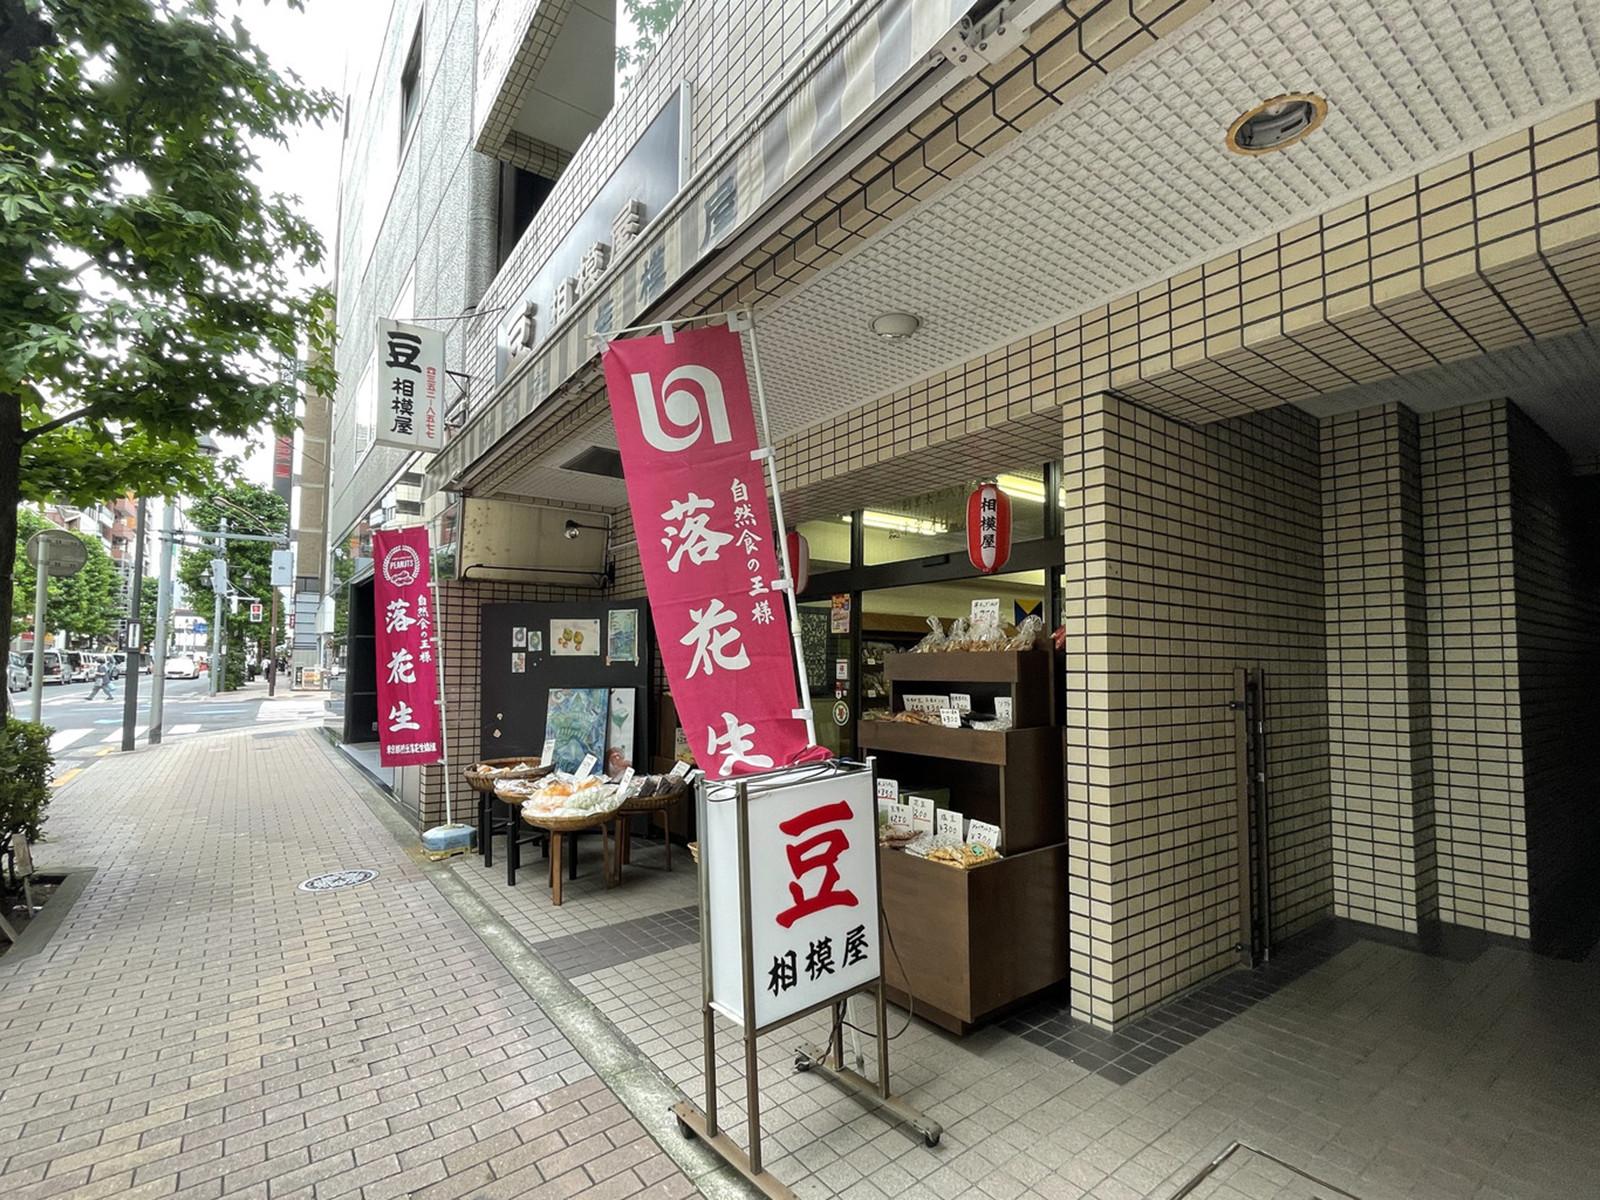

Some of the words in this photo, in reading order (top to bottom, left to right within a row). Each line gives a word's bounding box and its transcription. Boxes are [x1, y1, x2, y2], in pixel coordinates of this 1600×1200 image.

[385, 331, 422, 374] 豆
[390, 377, 415, 435] 相模屋
[729, 477, 776, 626] 自然食の王様
[980, 498, 997, 550] 相模屋
[390, 559, 414, 570] PEANUTS
[416, 594, 433, 663] 自然食の王様
[660, 491, 776, 777] 落花生
[385, 598, 421, 733] 落花生
[775, 799, 860, 929] 豆
[766, 923, 870, 998] 相模屋
